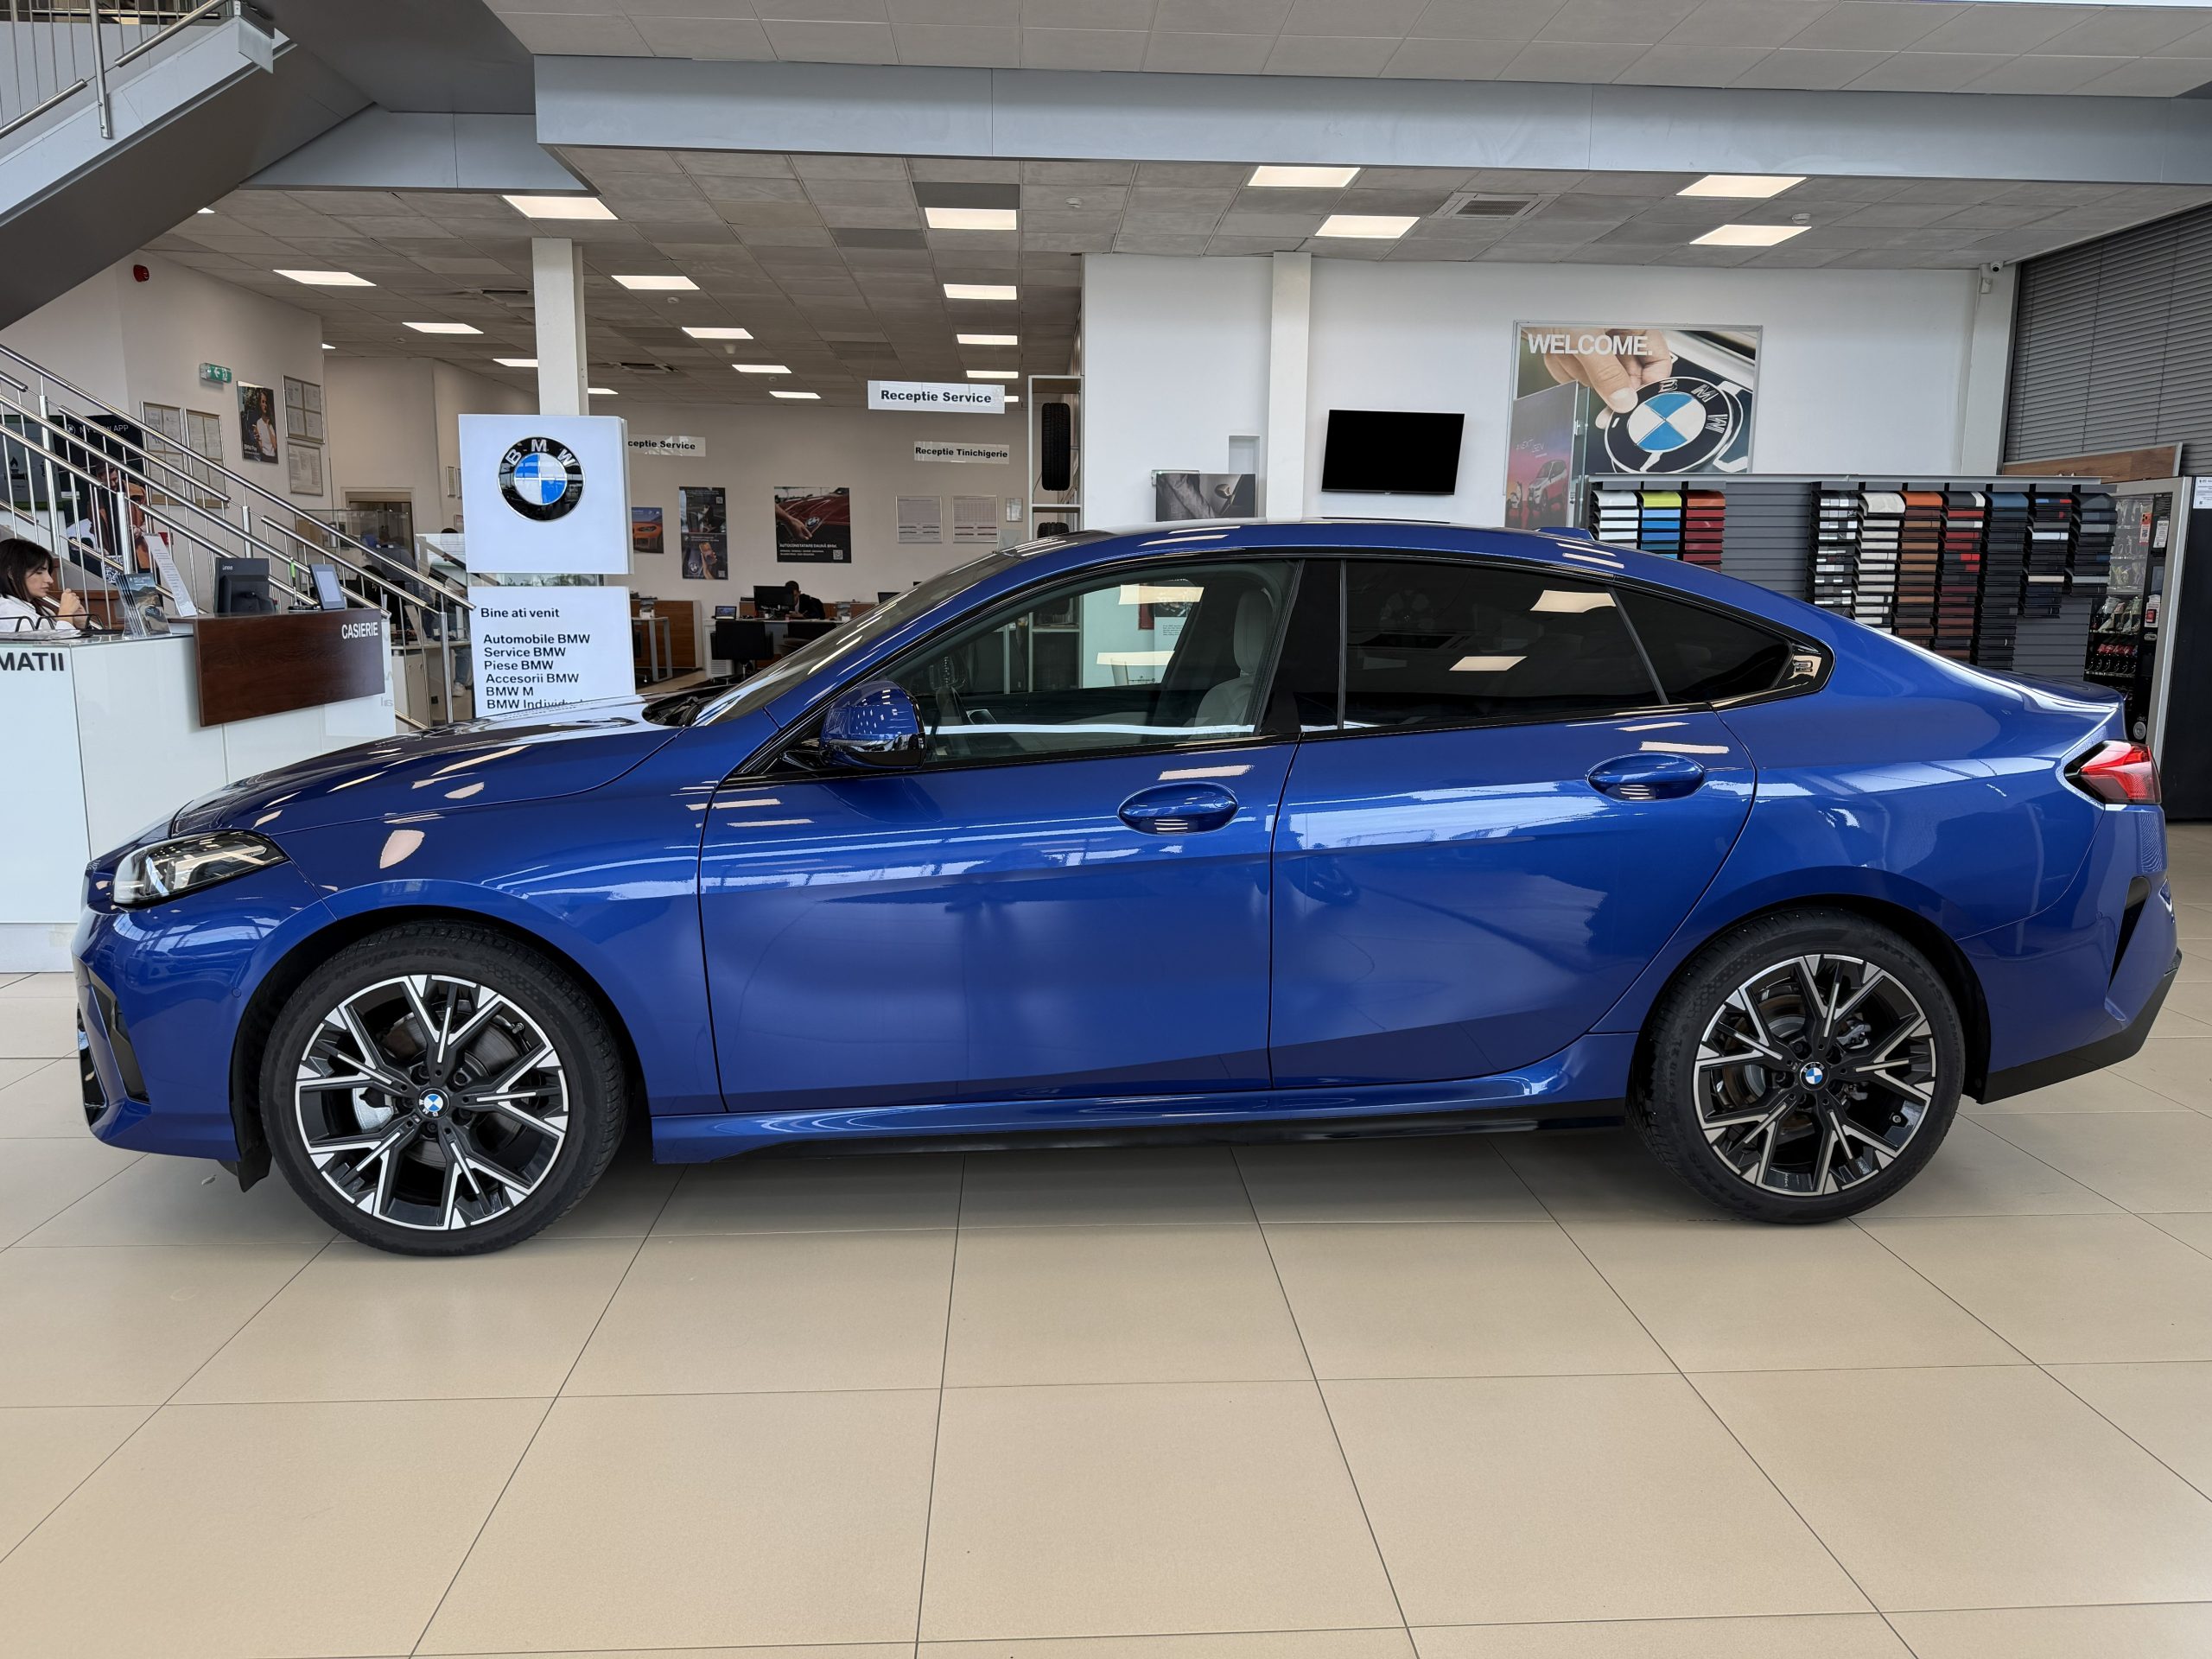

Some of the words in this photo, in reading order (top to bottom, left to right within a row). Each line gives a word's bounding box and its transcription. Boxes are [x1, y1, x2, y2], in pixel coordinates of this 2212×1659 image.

[1528, 334, 1653, 356] WELCOME.
[880, 391, 938, 403] Receptie
[943, 392, 992, 403] Service
[628, 440, 657, 448] ceptie
[660, 441, 696, 449] Service
[505, 439, 576, 466] BMW
[915, 447, 954, 456] Receptie
[957, 448, 1008, 459] Tinichigerie
[480, 607, 509, 618] Bine
[512, 607, 527, 618] ati
[529, 607, 560, 618] venit
[341, 622, 378, 639] CASIERIE
[483, 634, 555, 644] Automobile
[557, 633, 590, 644] BMW
[484, 647, 531, 657] Service
[533, 647, 566, 657] BMW
[0, 652, 65, 671] MATII
[484, 660, 518, 670] Piese
[521, 660, 554, 670] BMW
[486, 673, 543, 683] Accesorii
[546, 673, 579, 683] BMW
[486, 686, 518, 696] BMW
[523, 686, 534, 696] M
[486, 699, 519, 709] BMW
[523, 698, 582, 709] Individ
